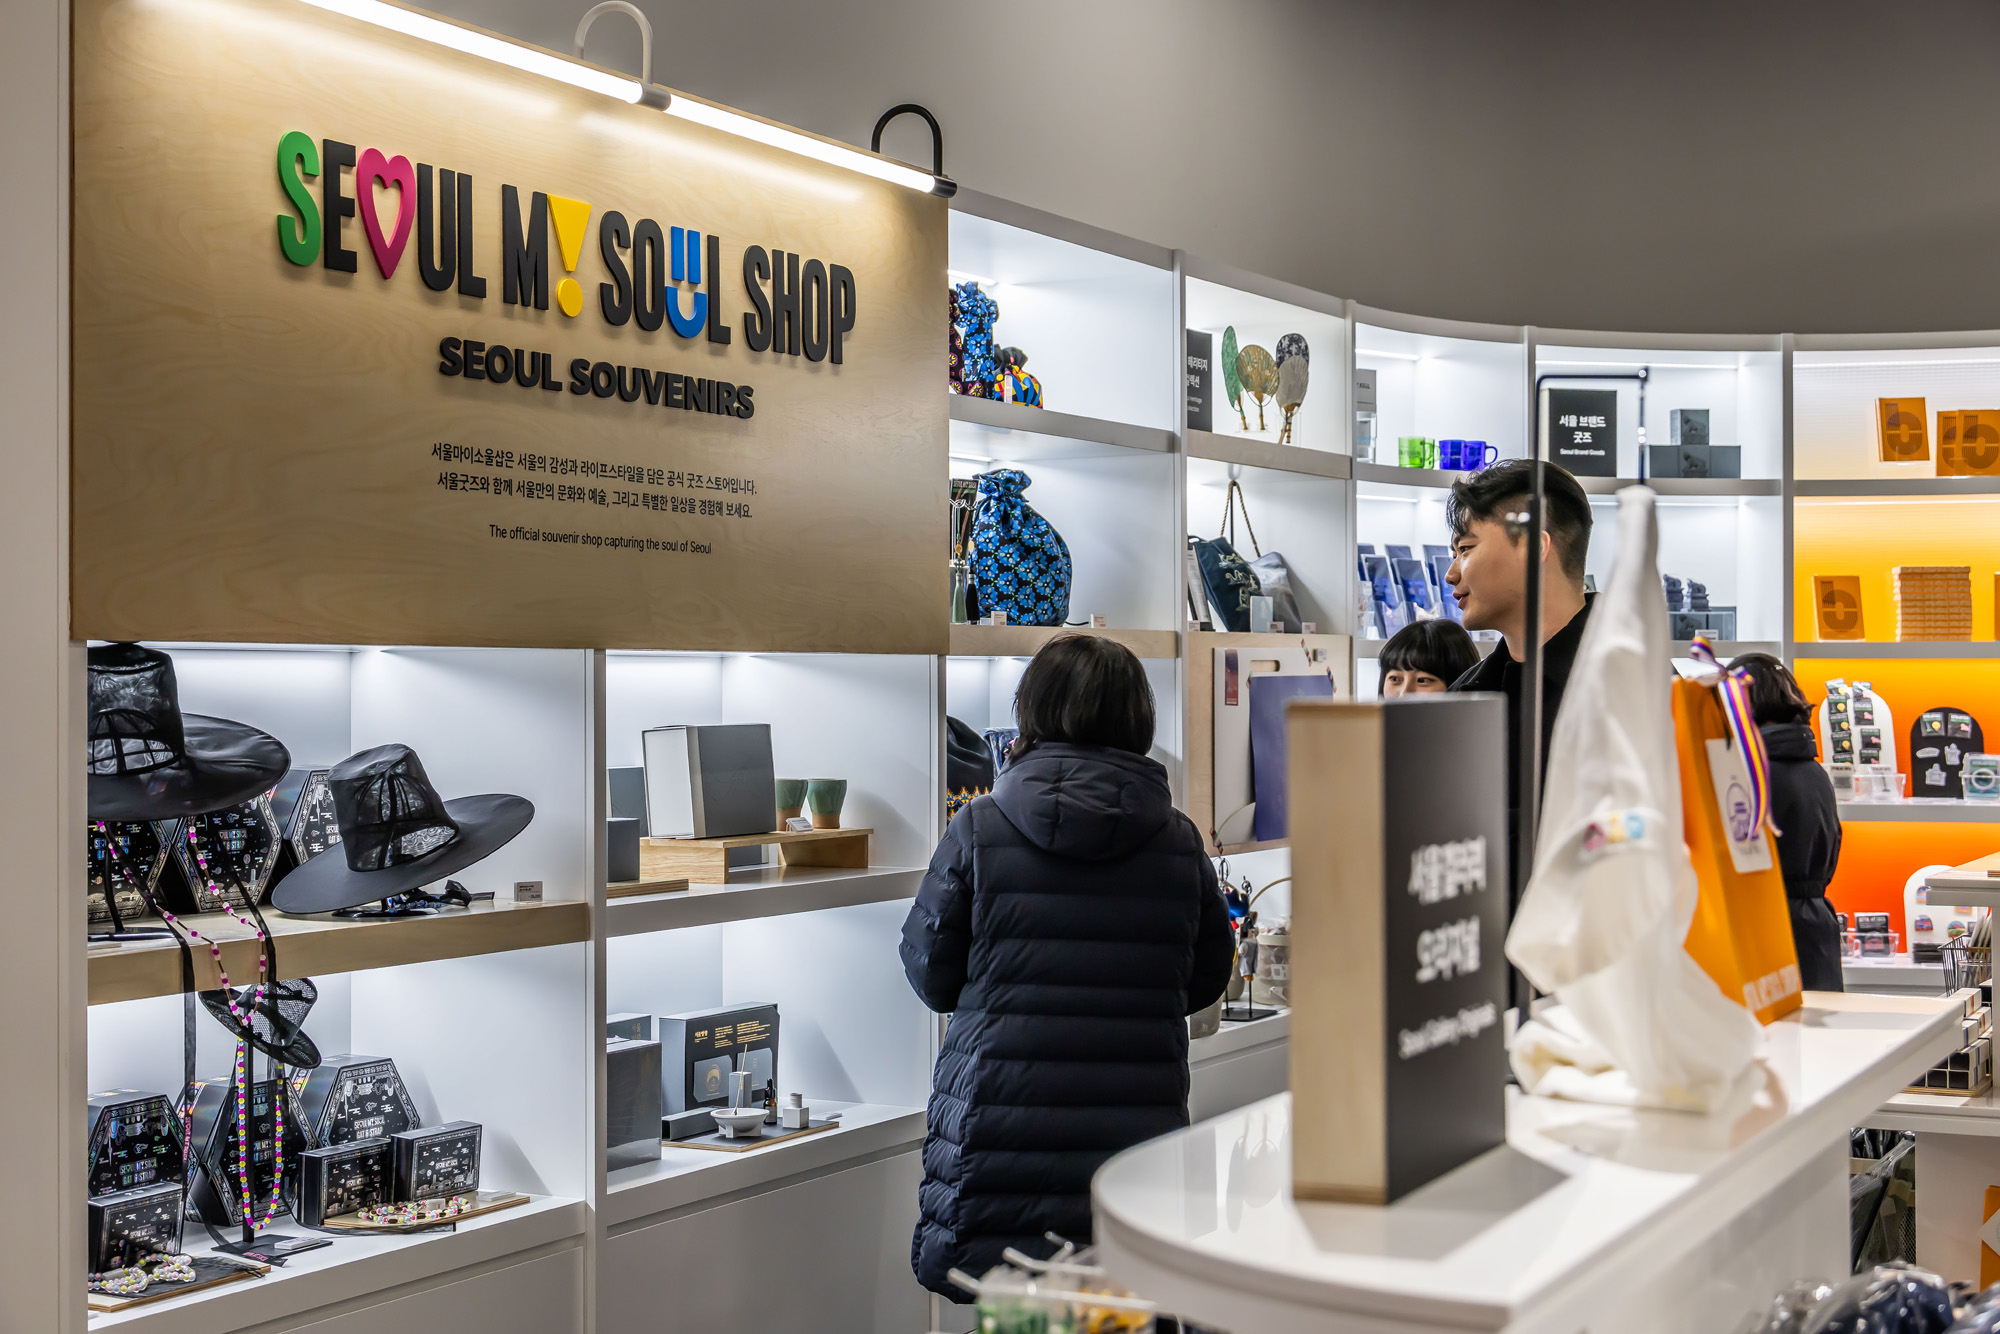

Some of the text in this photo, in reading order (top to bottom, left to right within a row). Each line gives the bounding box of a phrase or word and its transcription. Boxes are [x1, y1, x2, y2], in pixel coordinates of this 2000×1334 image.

[600, 210, 731, 345] SOUL
[744, 245, 857, 365] SHOP
[439, 336, 755, 420] SEOUL SOUVENIRS
[1559, 414, 1607, 428] 서울 브랜드
[1573, 431, 1593, 444] 굿즈
[431, 442, 757, 496] 서울마이소울샵은 서울의 감성과 라이프스타일을 담은 공식 굿즈 스토어입니다.
[1560, 448, 1574, 456] Seoul
[1574, 448, 1589, 456] Brand
[437, 471, 753, 519] 서울굿즈와 함께 서울만의 문화와 예술, 그리고 특별한 일상을 경험해 보세요.
[489, 524, 712, 554] The official souvenir shop capturing the soul of Seoul
